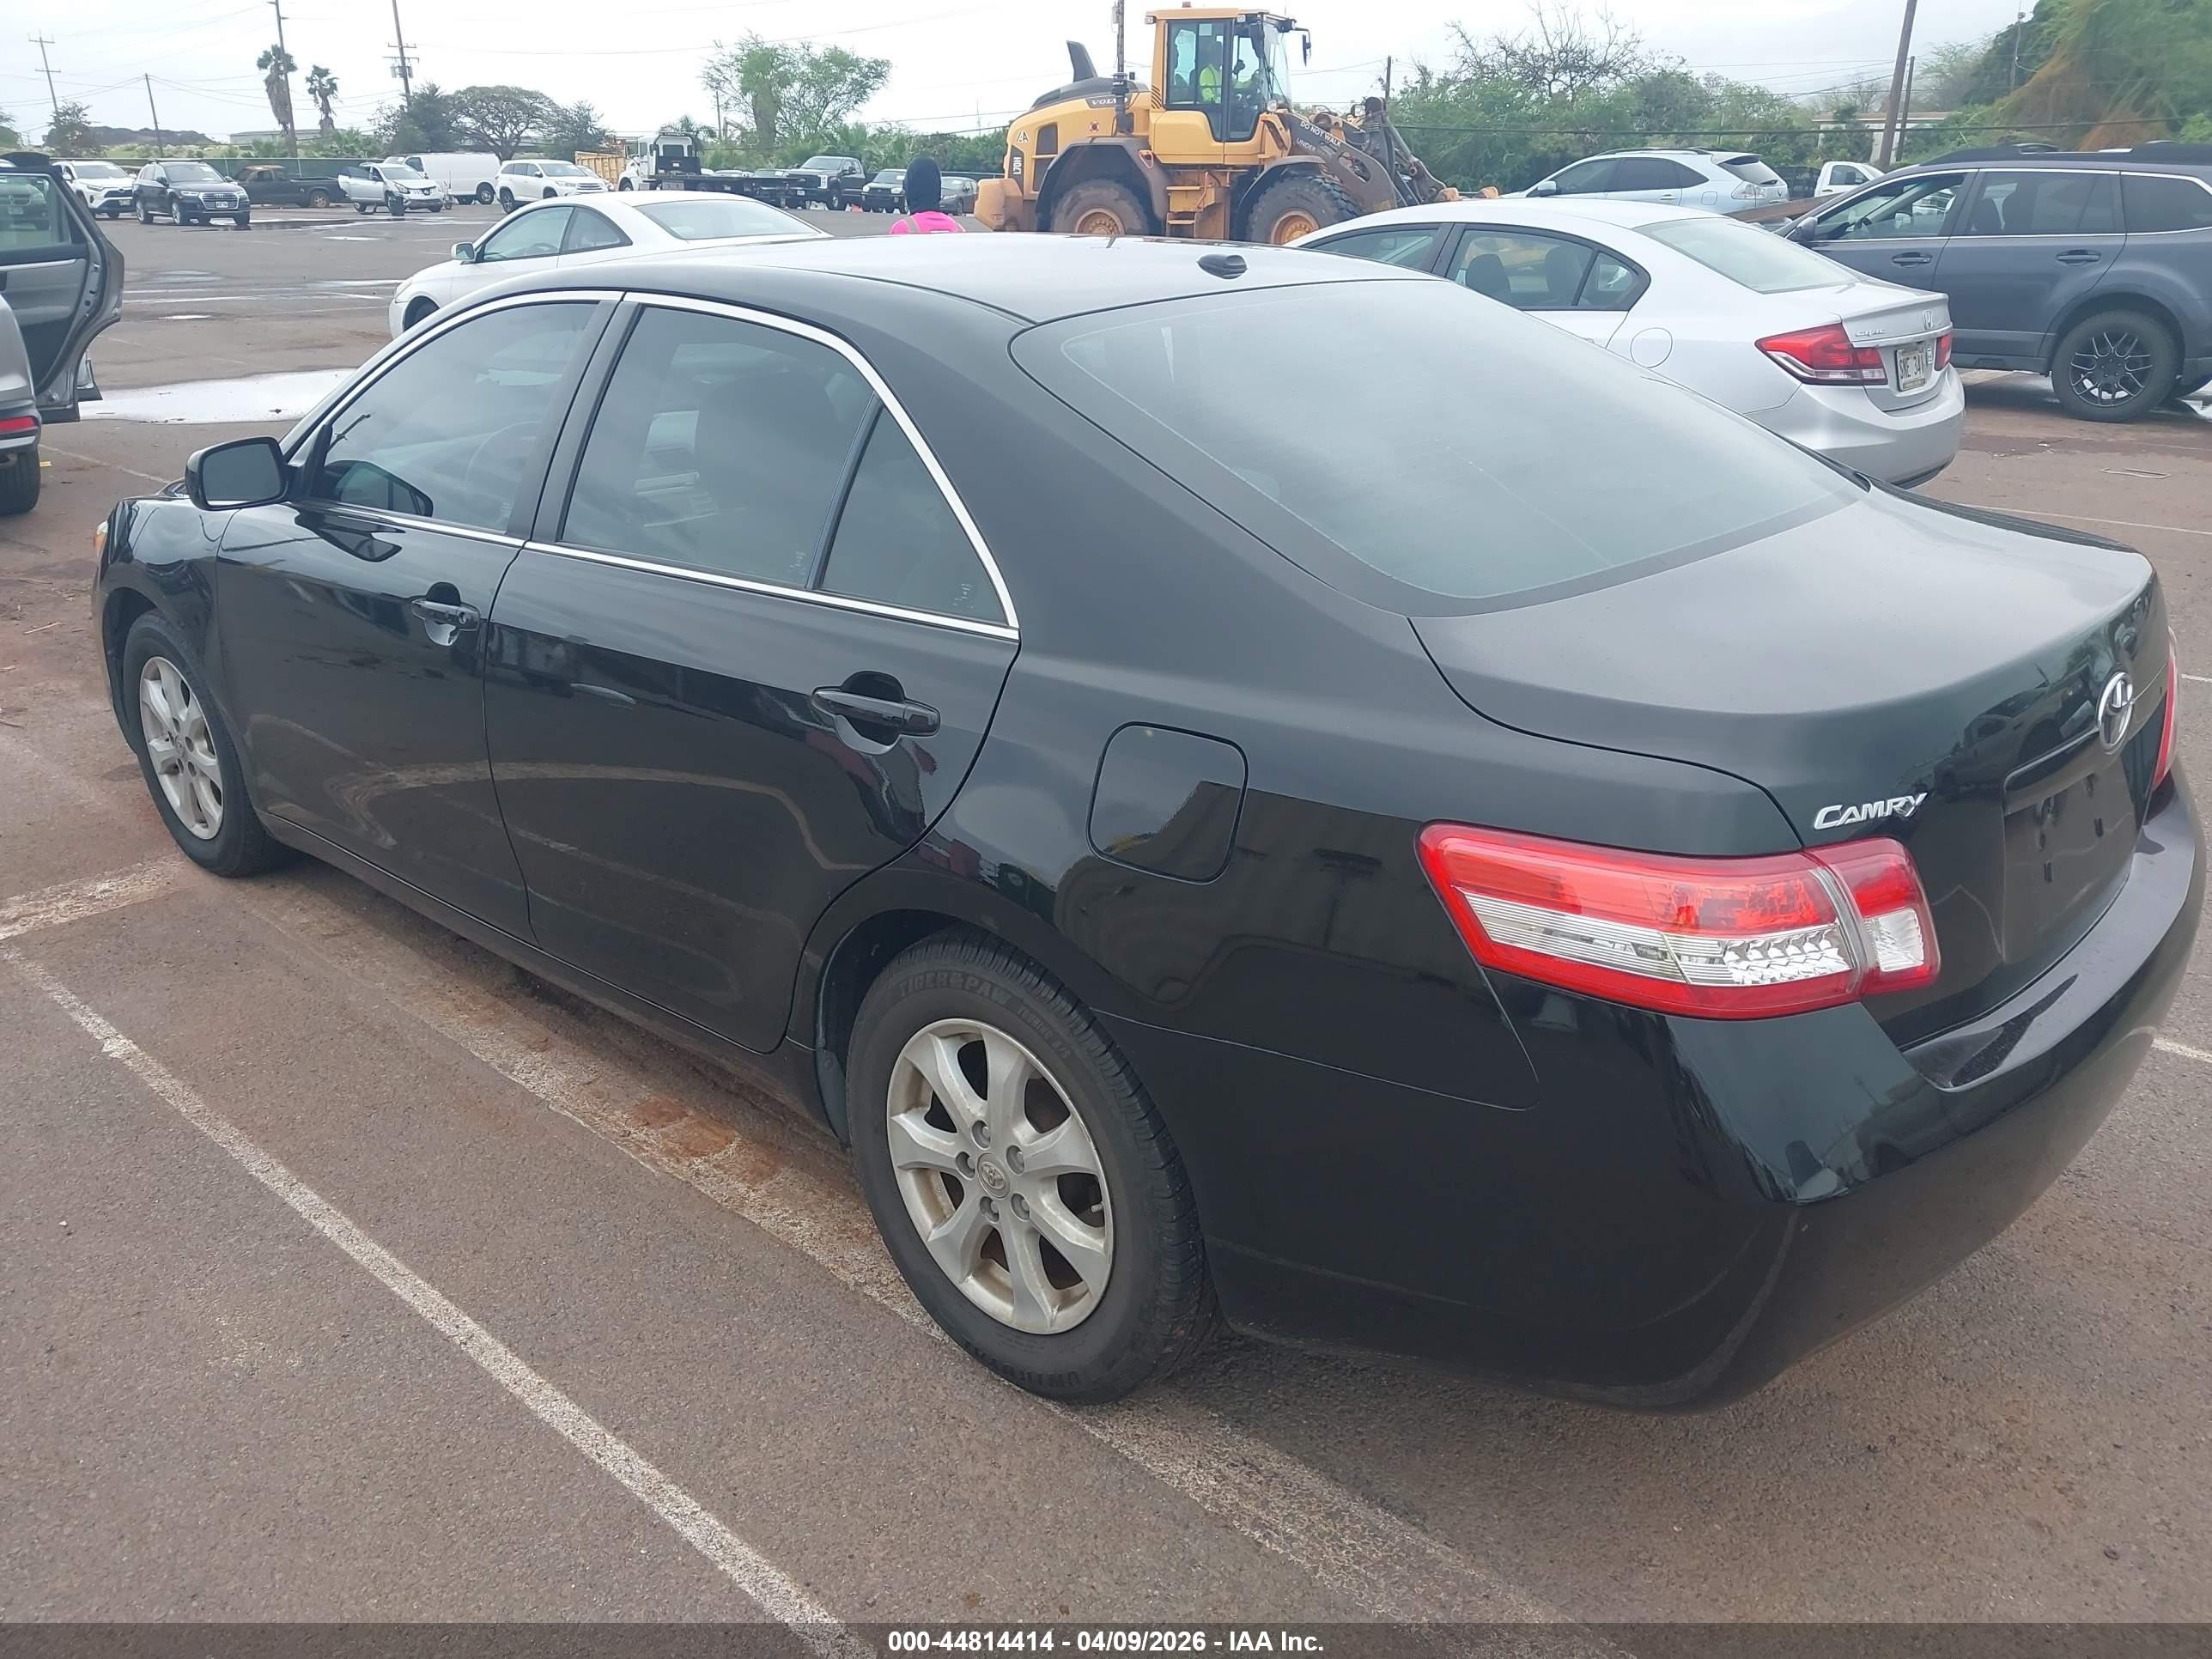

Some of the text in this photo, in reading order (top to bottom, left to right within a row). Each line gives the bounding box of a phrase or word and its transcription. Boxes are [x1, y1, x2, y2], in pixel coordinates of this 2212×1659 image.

[1297, 137, 1316, 151] UNDER
[1300, 121, 1341, 147] DO NOT WALK
[1013, 156, 1022, 174] L70H
[1814, 792, 1928, 830] CAMRY
